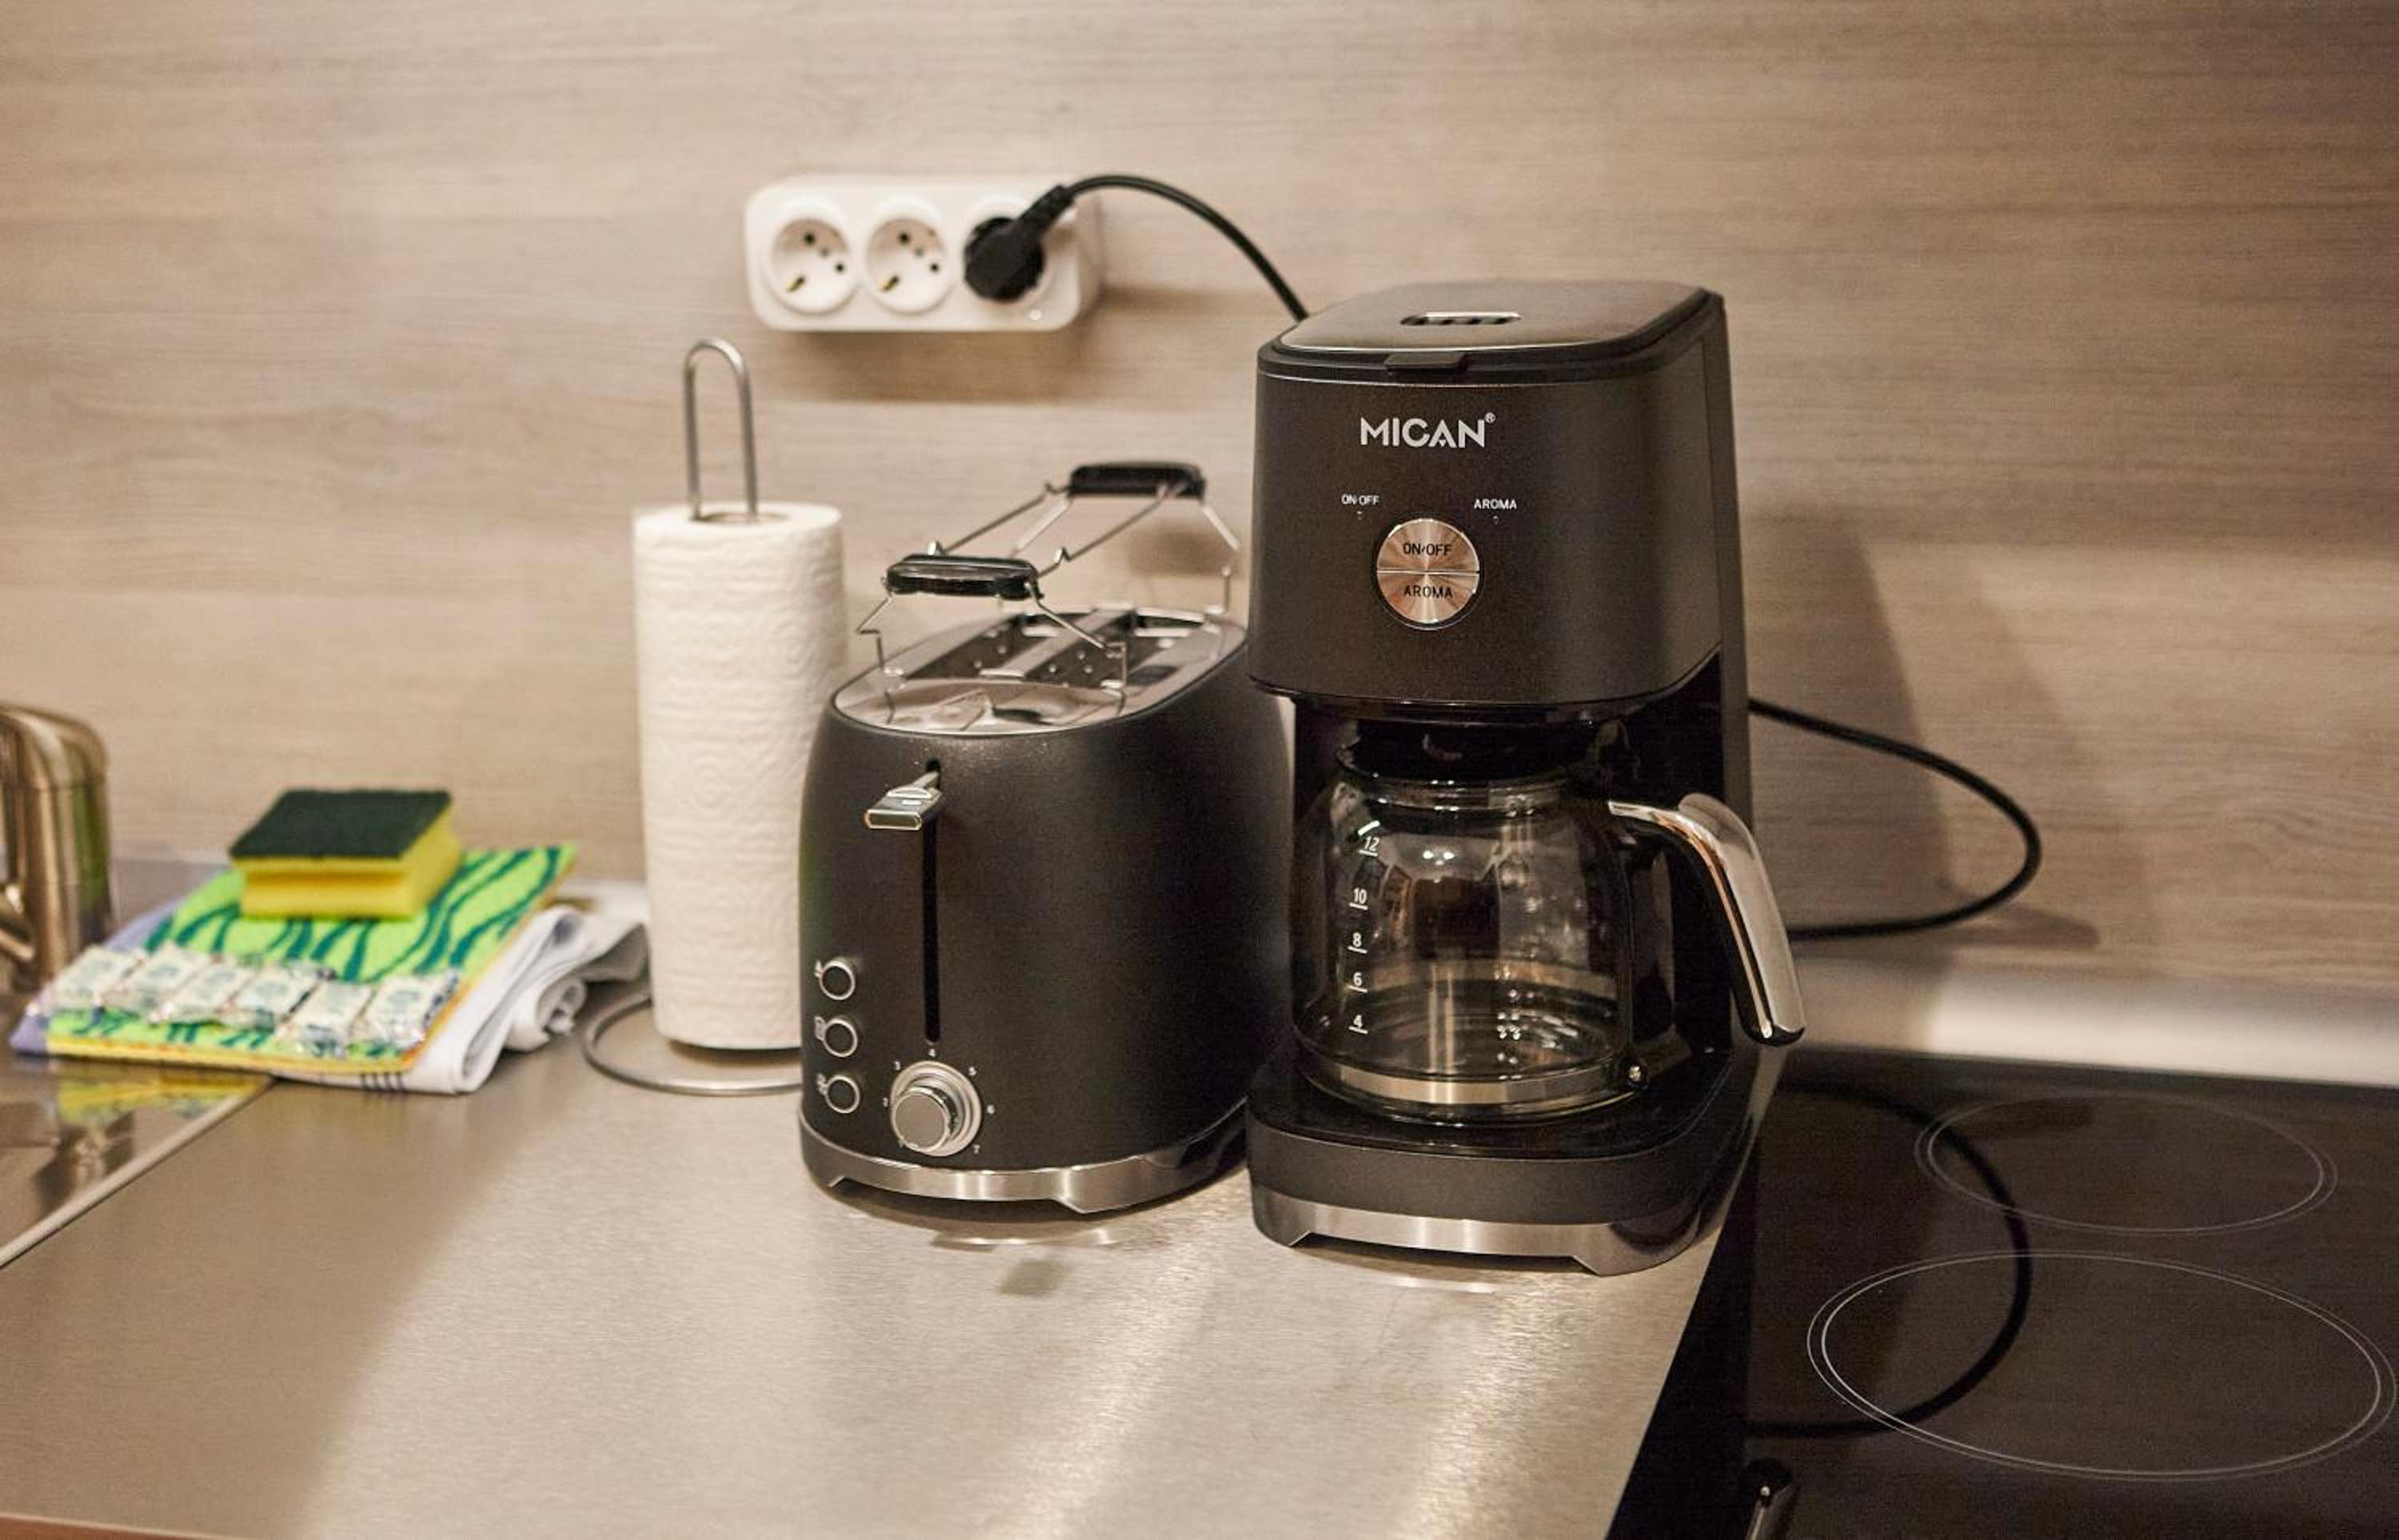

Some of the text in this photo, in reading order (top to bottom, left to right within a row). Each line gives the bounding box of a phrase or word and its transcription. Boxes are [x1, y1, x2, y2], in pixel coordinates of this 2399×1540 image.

[1474, 499, 1517, 509] AROMA
[1403, 542, 1452, 557] ON/OFF
[1403, 584, 1453, 599] AROMA
[1364, 836, 1379, 852] 12
[1354, 888, 1367, 904] 10
[1352, 932, 1362, 948] 8
[1353, 971, 1362, 986] 6
[1353, 1015, 1363, 1028] 4
